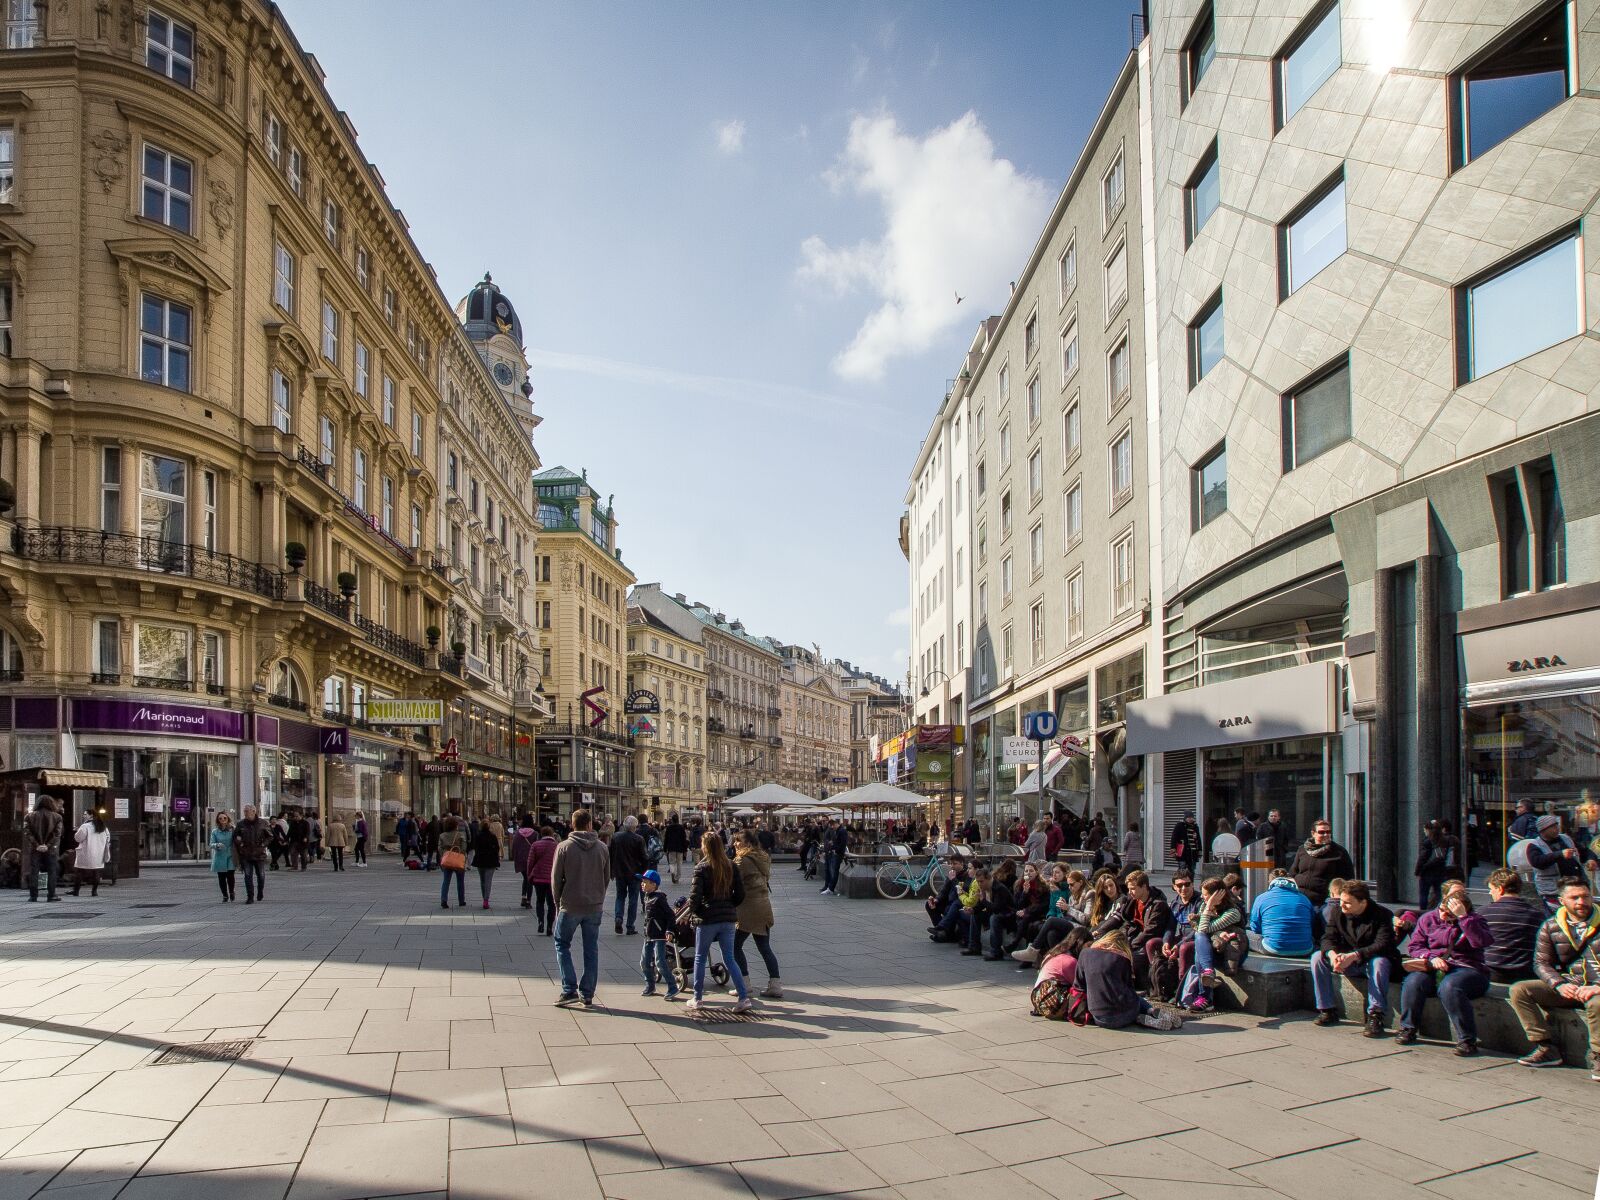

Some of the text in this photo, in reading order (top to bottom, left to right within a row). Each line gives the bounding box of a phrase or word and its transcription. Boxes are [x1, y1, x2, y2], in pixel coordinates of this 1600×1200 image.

[1507, 655, 1567, 672] ZARA
[132, 707, 204, 724] Marionnaud
[372, 701, 436, 718] STURMAYR
[1024, 716, 1031, 736] U
[1037, 716, 1054, 735] U
[1218, 715, 1252, 728] ZARA
[324, 730, 342, 748] M
[424, 764, 456, 773] APOTHEKE
